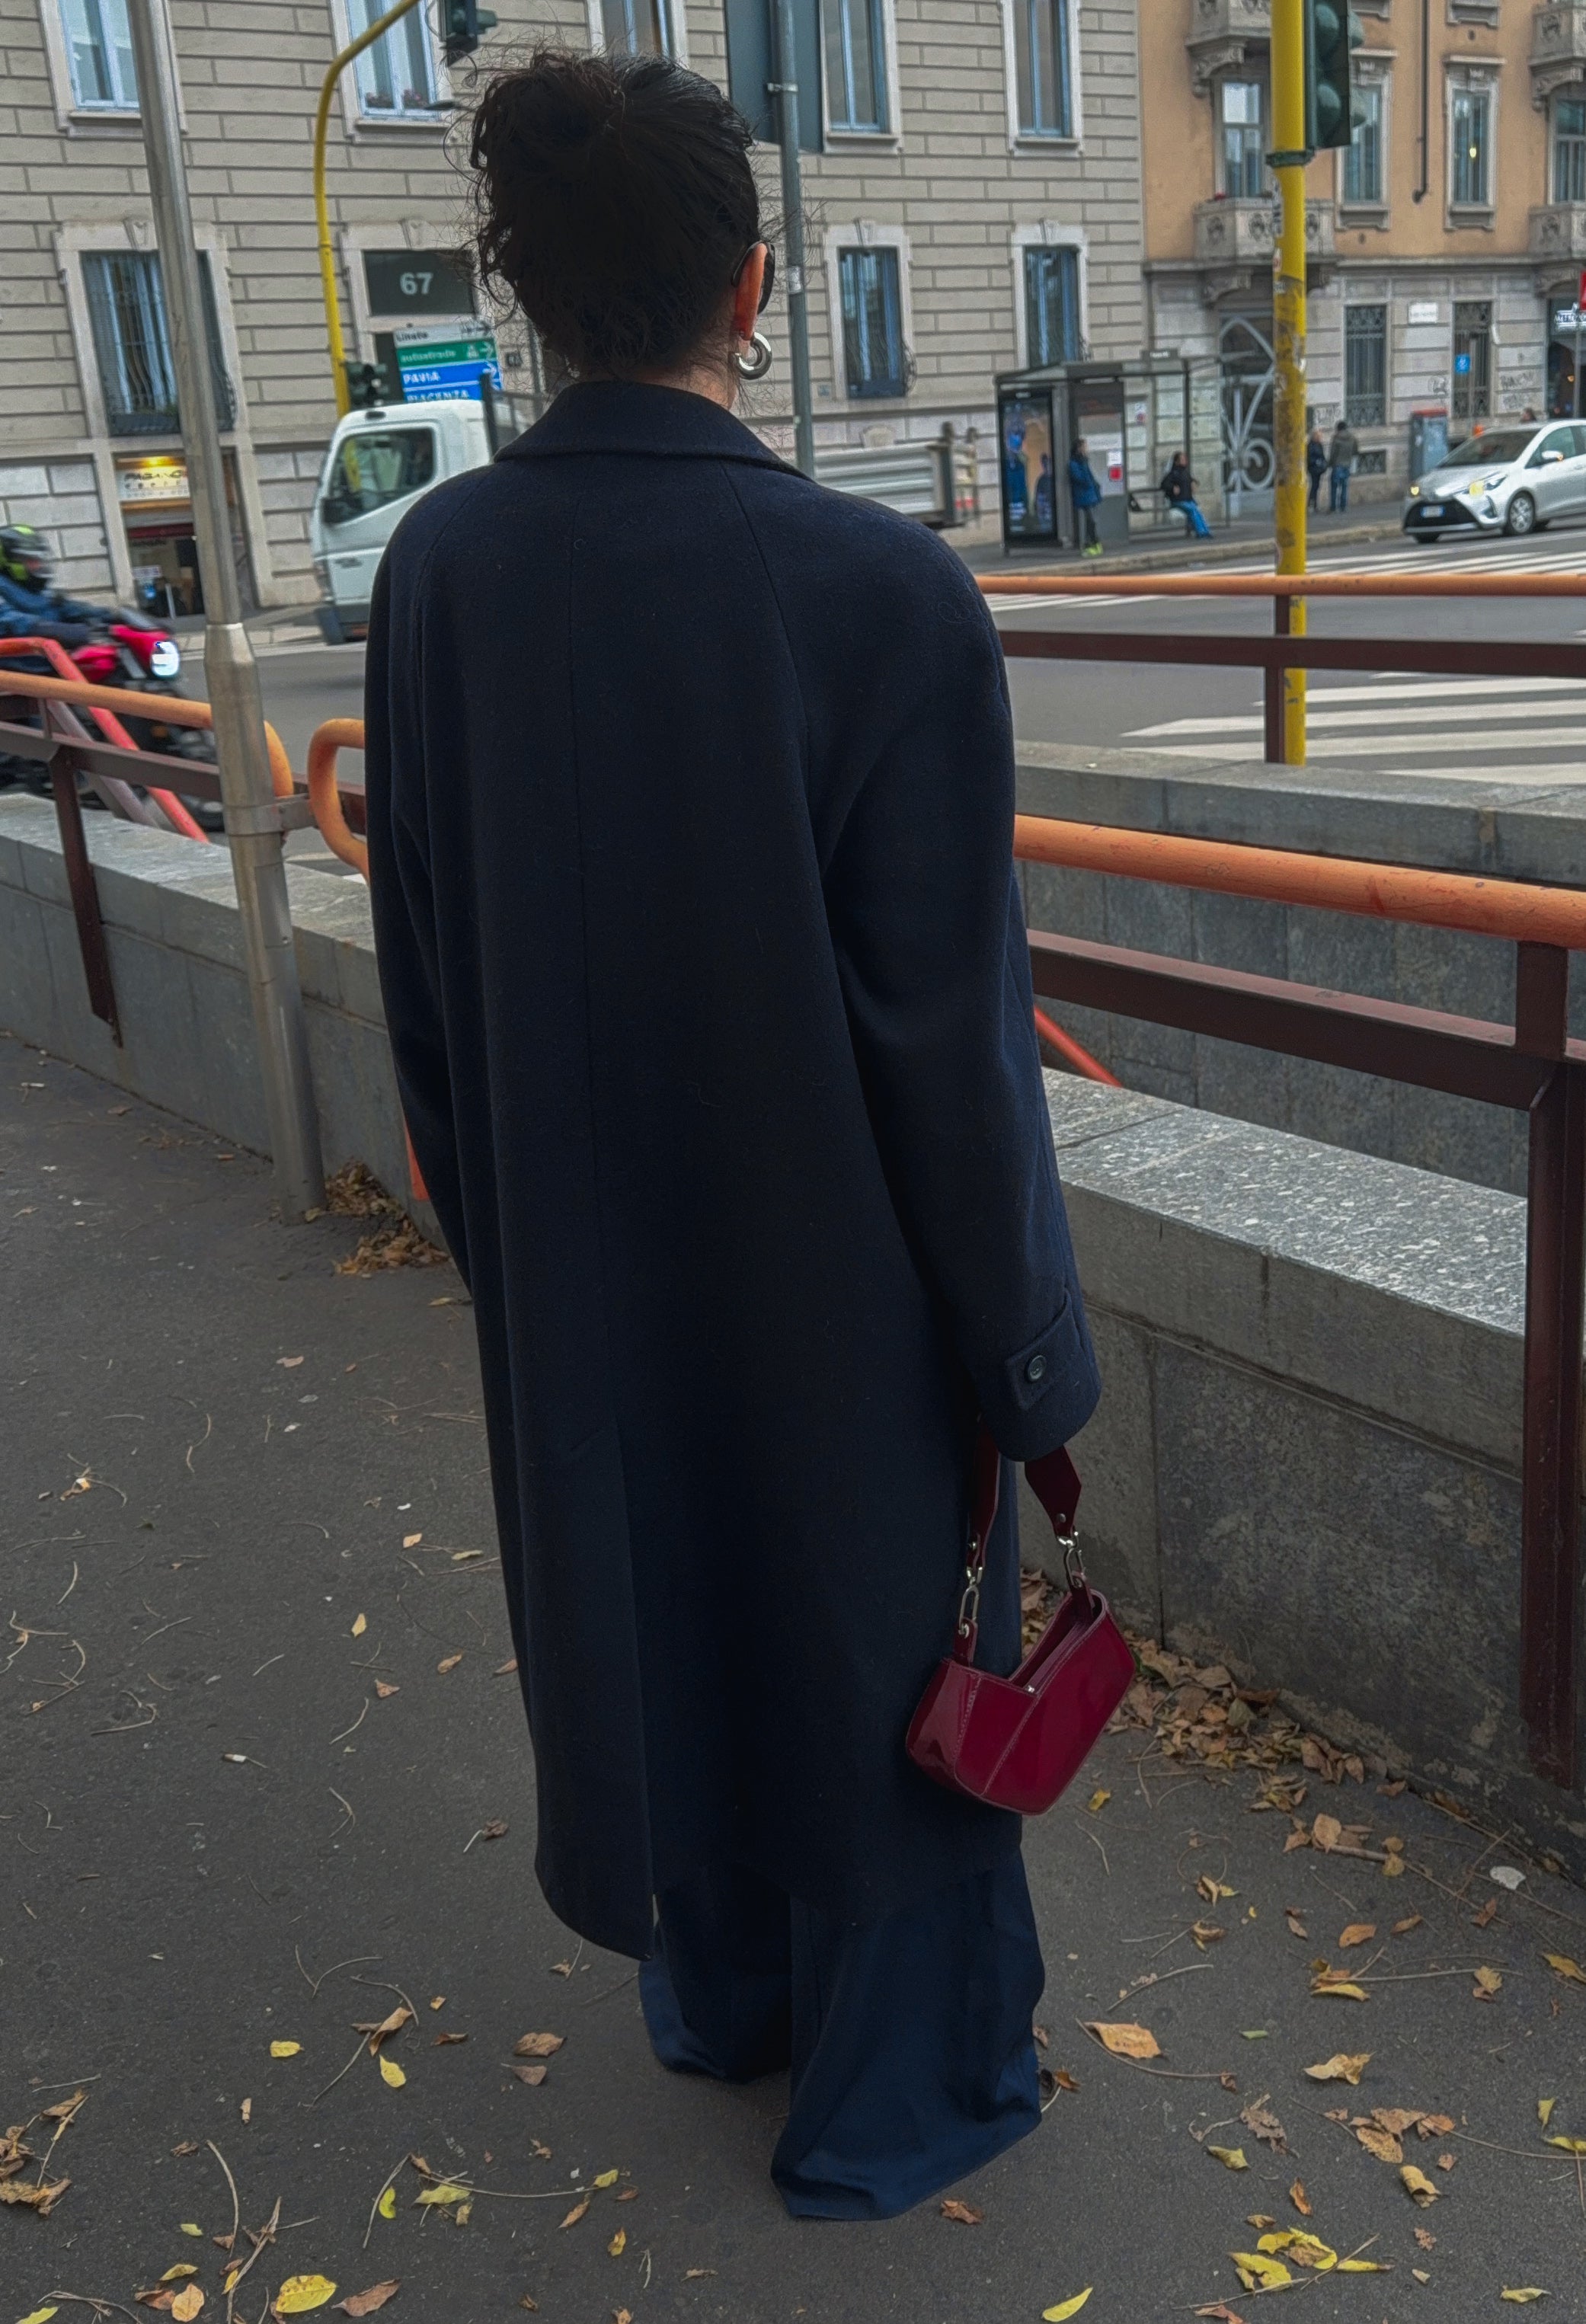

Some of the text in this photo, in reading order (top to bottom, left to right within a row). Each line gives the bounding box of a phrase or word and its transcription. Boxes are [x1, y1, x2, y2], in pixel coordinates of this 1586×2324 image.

[400, 272, 433, 295] 67
[403, 371, 440, 384] PAVIA
[407, 389, 469, 403] PIACENZA
